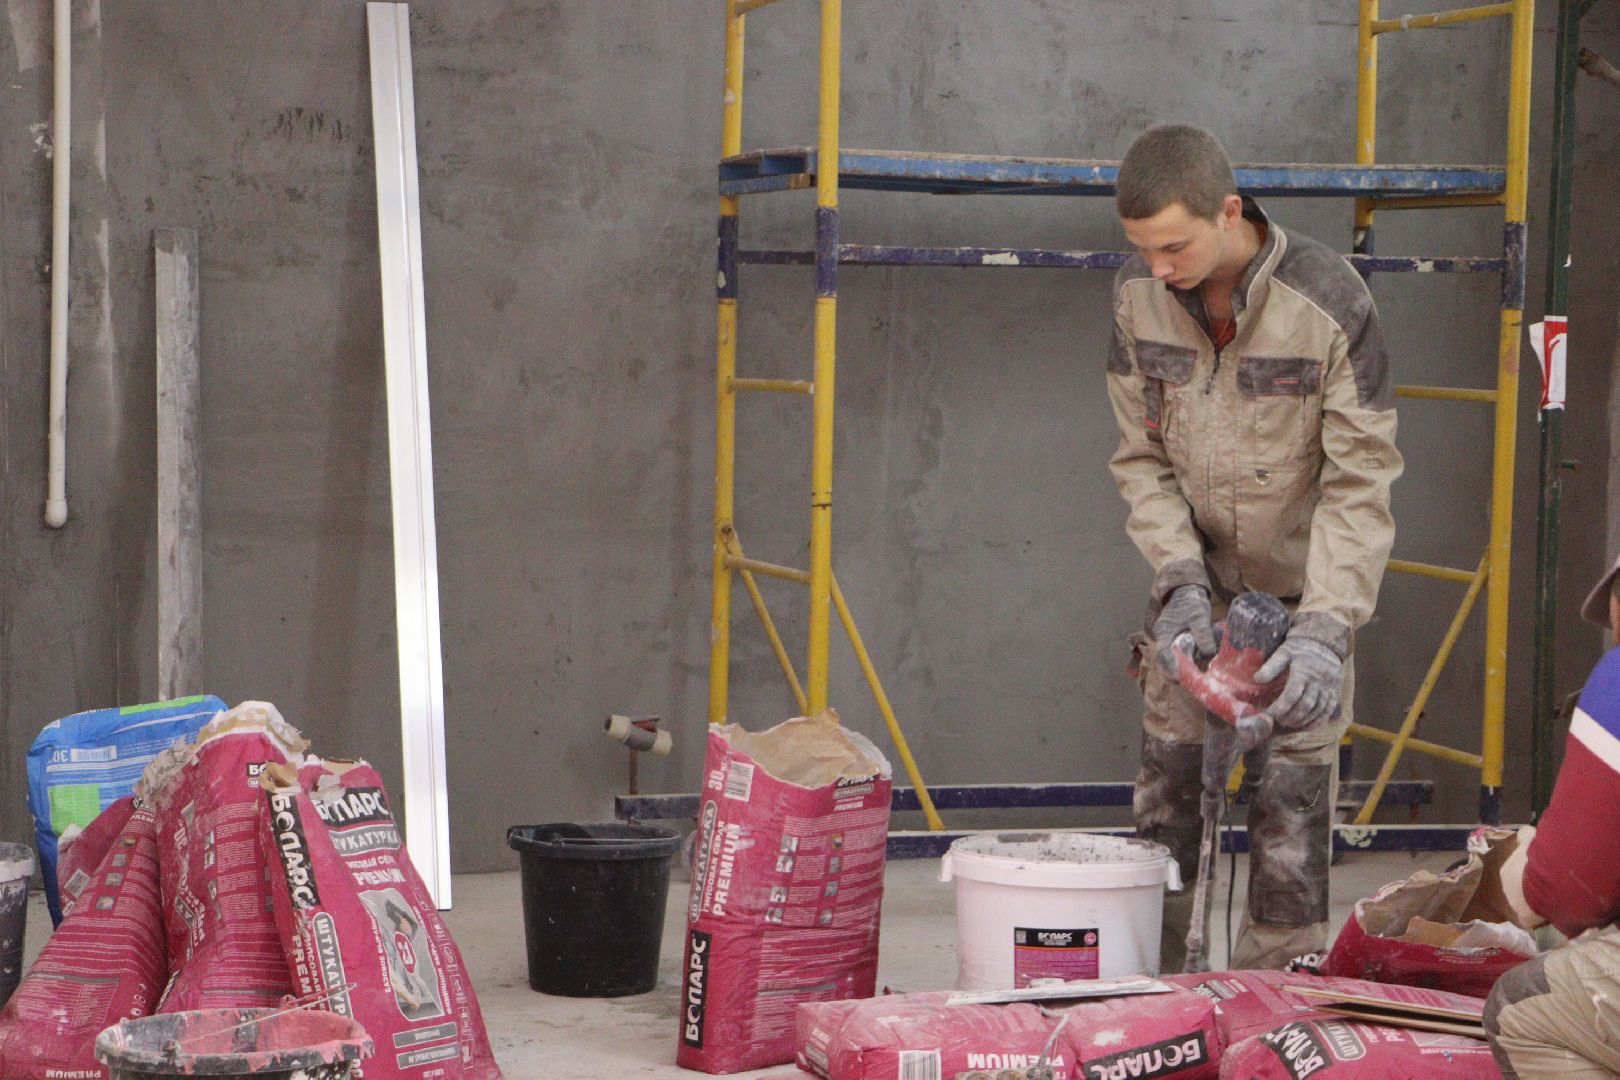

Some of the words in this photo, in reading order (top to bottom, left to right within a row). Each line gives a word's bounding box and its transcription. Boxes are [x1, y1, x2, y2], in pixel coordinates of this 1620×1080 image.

[708, 769, 723, 790] 30
[271, 794, 317, 909] БОЛАРС
[692, 807, 715, 917] ШТУКАТУРКА
[713, 823, 741, 916] PREMIUM
[684, 935, 707, 1043] БОЛАРС
[46, 1069, 102, 1079] PREMIUM
